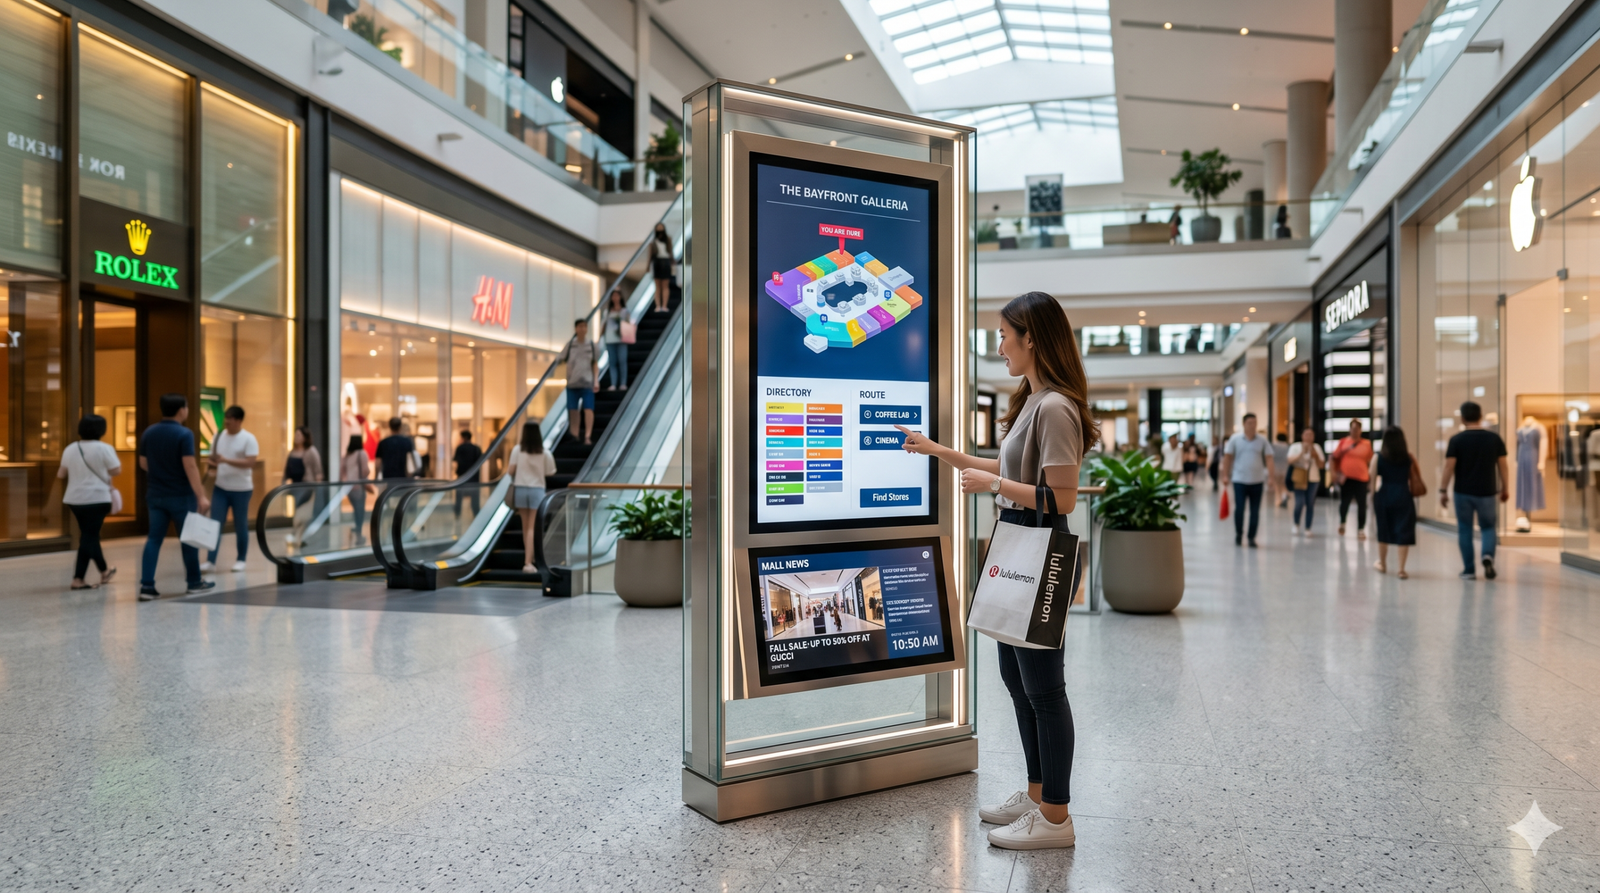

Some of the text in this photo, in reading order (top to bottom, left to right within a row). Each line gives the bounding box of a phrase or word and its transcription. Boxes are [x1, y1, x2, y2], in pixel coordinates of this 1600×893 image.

[779, 183, 909, 211] THE BAYFRONT GALLERIA
[821, 226, 834, 234] YOU
[834, 228, 846, 236] ARE
[94, 250, 179, 289] ROLEX
[1325, 280, 1369, 333] SEPHORA
[766, 387, 812, 397] DIRECTORY
[859, 390, 886, 399] ROUTE
[874, 411, 910, 419] COFFEE LAB
[875, 436, 899, 445] CINEMA
[872, 492, 909, 502] Find Stores
[761, 559, 809, 571] MALL NEWS
[999, 568, 1035, 584] lululemon
[1041, 552, 1065, 623] lululemon
[769, 644, 788, 653] FALL
[821, 638, 831, 647] TO
[832, 636, 847, 645] 50%
[847, 634, 861, 643] OFF
[861, 633, 870, 642] AT
[892, 634, 939, 651] 10:50 AM
[770, 652, 794, 662] GUCCI
